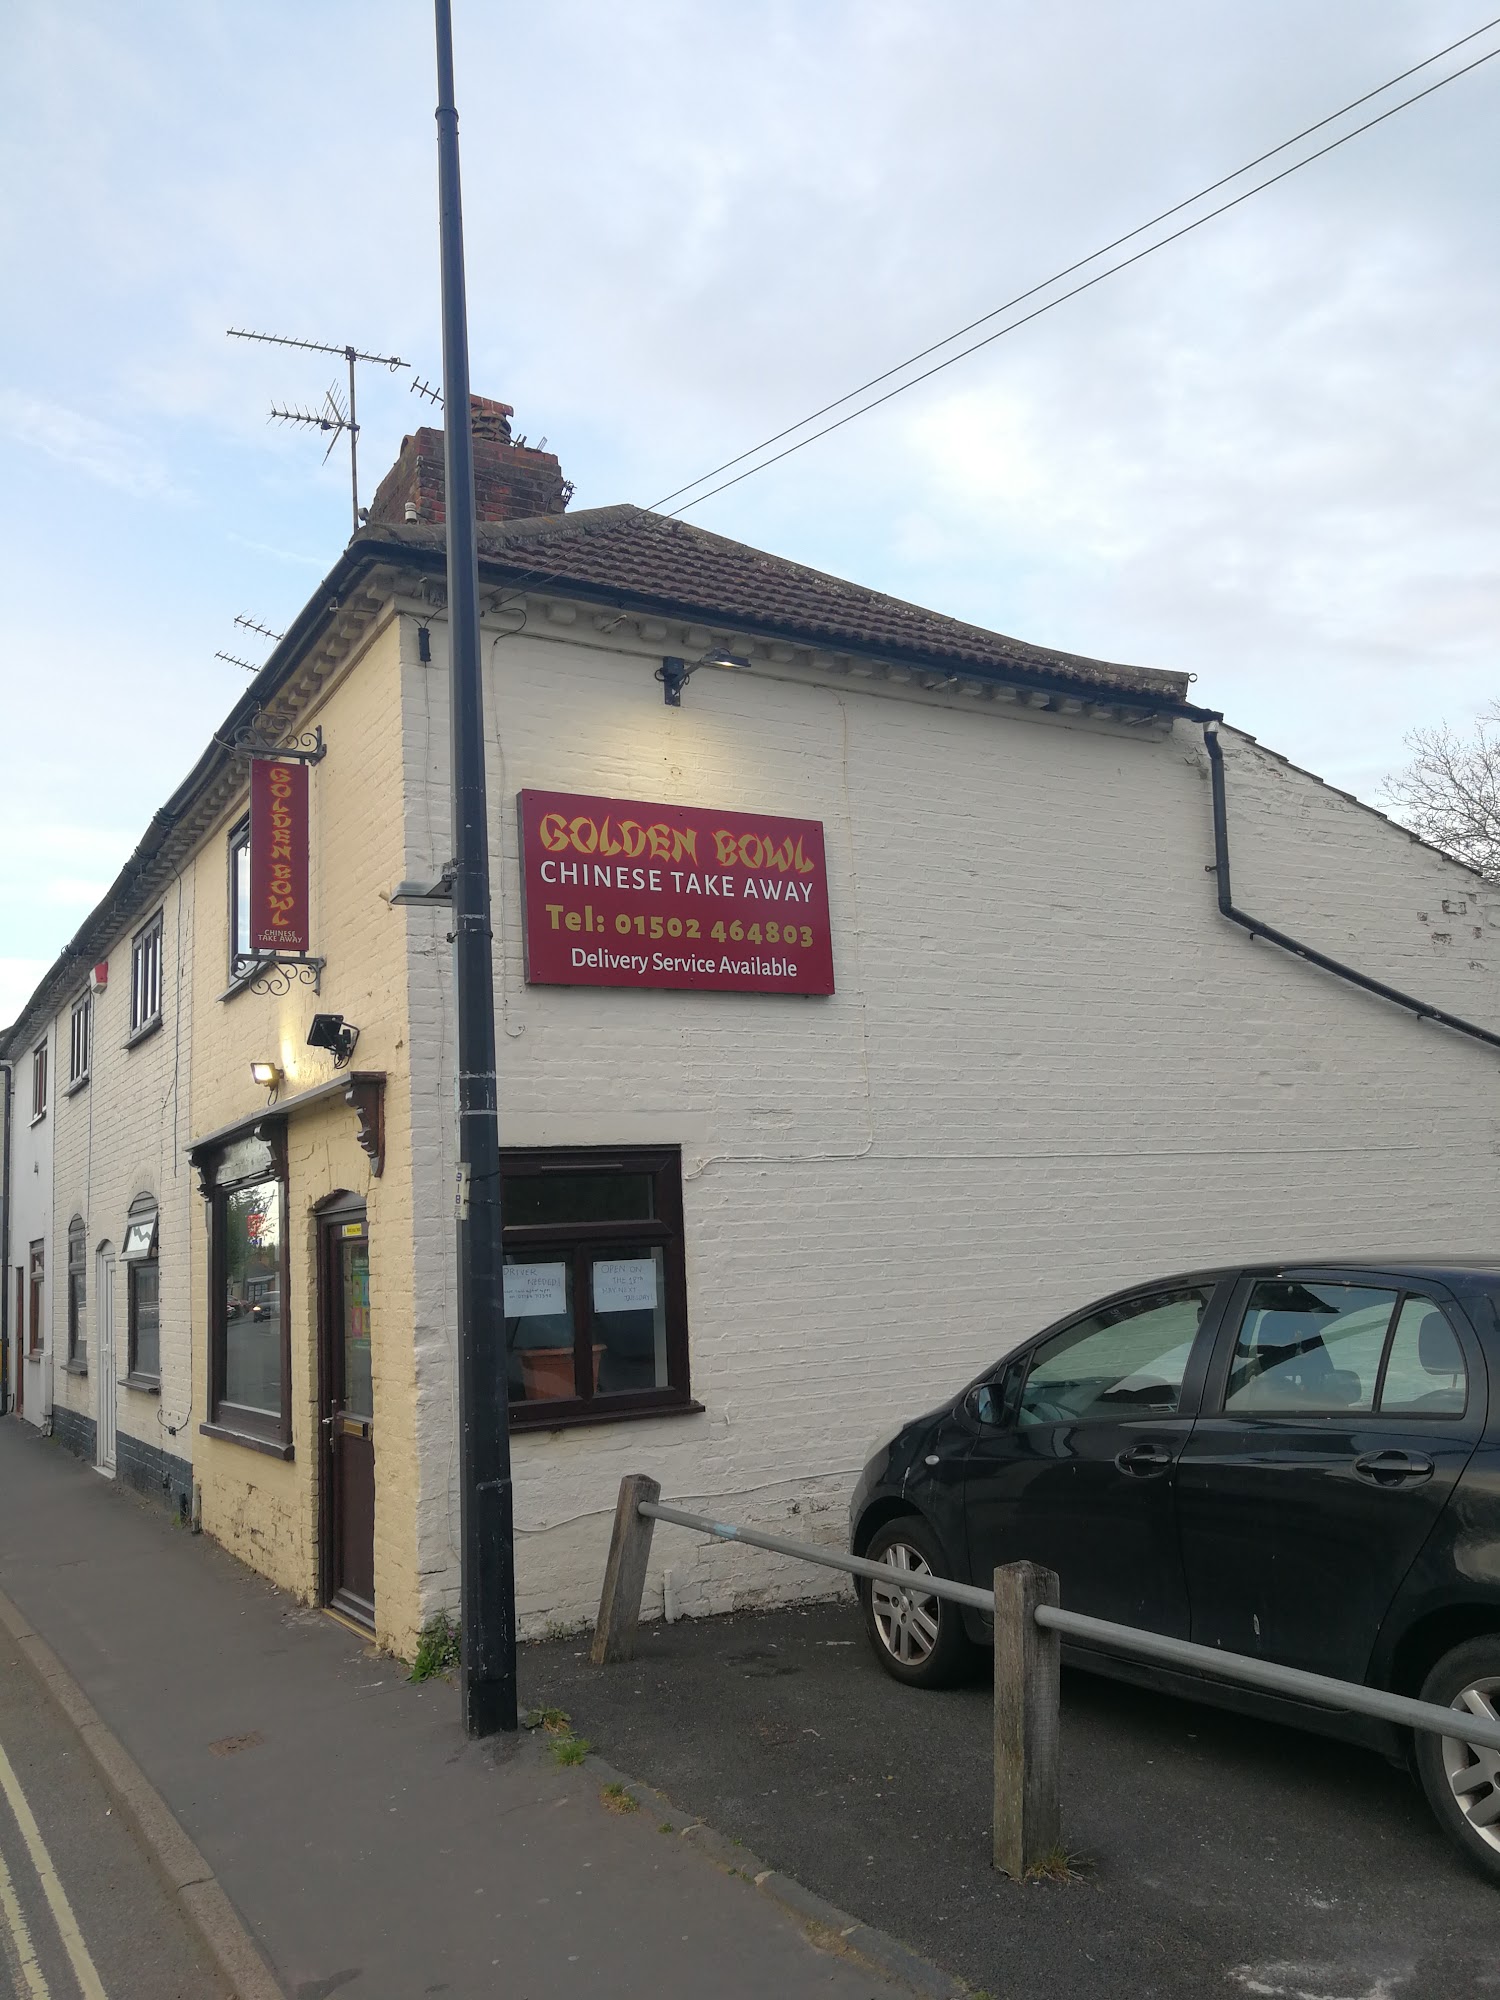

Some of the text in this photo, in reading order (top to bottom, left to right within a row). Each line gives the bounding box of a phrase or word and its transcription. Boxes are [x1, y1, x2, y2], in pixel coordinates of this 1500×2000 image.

[270, 767, 292, 860] GOLDEN
[539, 813, 815, 873] GOLDEN BOWL
[268, 864, 294, 925] BOWL
[540, 860, 813, 903] CHINESE TAKE AWAY
[258, 934, 303, 944] TAKE AWAY
[264, 929, 296, 937] CHINESE
[545, 904, 814, 948] Tel: 01502 464803
[571, 948, 798, 977] Delivery Service Available
[503, 1267, 538, 1276] DRIVER
[601, 1264, 642, 1274] OPEN ON
[612, 1276, 626, 1284] THE
